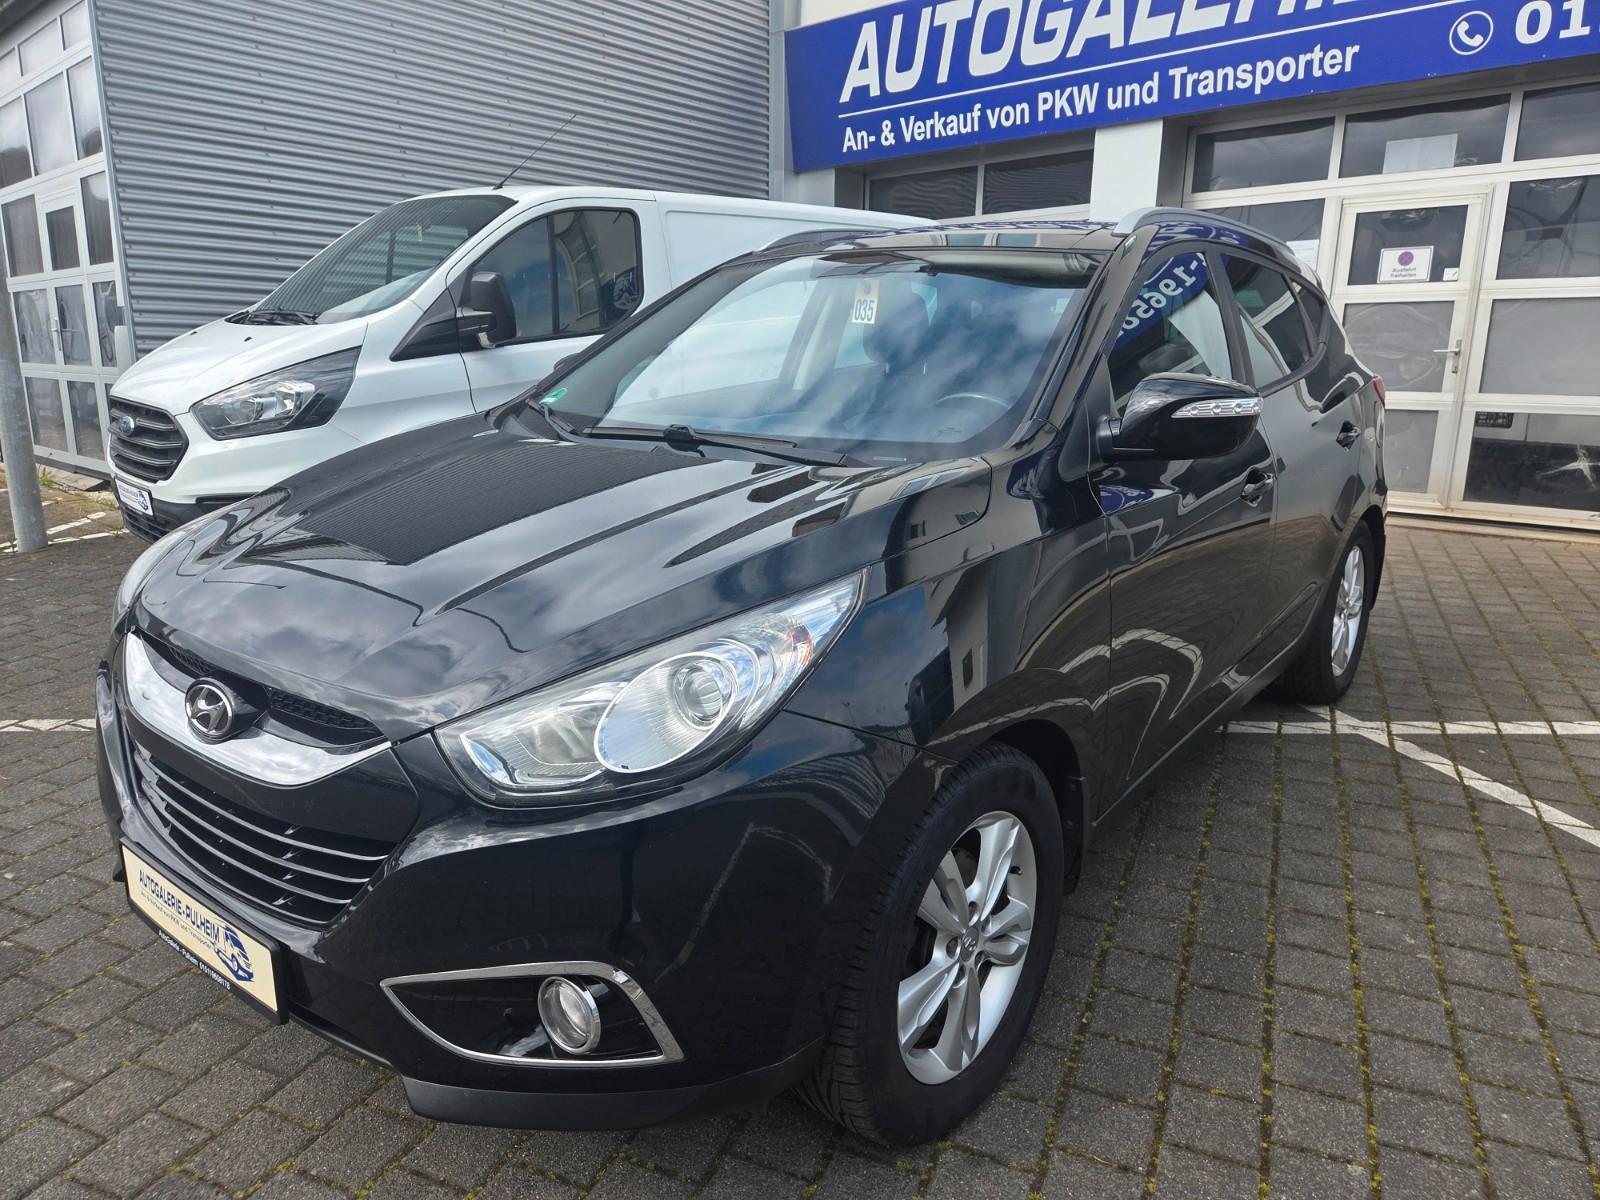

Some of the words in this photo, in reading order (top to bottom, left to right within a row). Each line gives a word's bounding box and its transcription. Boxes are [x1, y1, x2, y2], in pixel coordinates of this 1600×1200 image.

[839, 0, 1357, 104] AUTOGAL
[1515, 0, 1600, 45] 01
[842, 127, 876, 152] An-
[880, 120, 896, 146] &
[900, 103, 982, 143] Verkauf
[986, 102, 1030, 129] von
[1038, 82, 1099, 121] PKW
[1107, 72, 1159, 110] und
[1169, 44, 1360, 100] Transporter
[854, 298, 876, 322] 035
